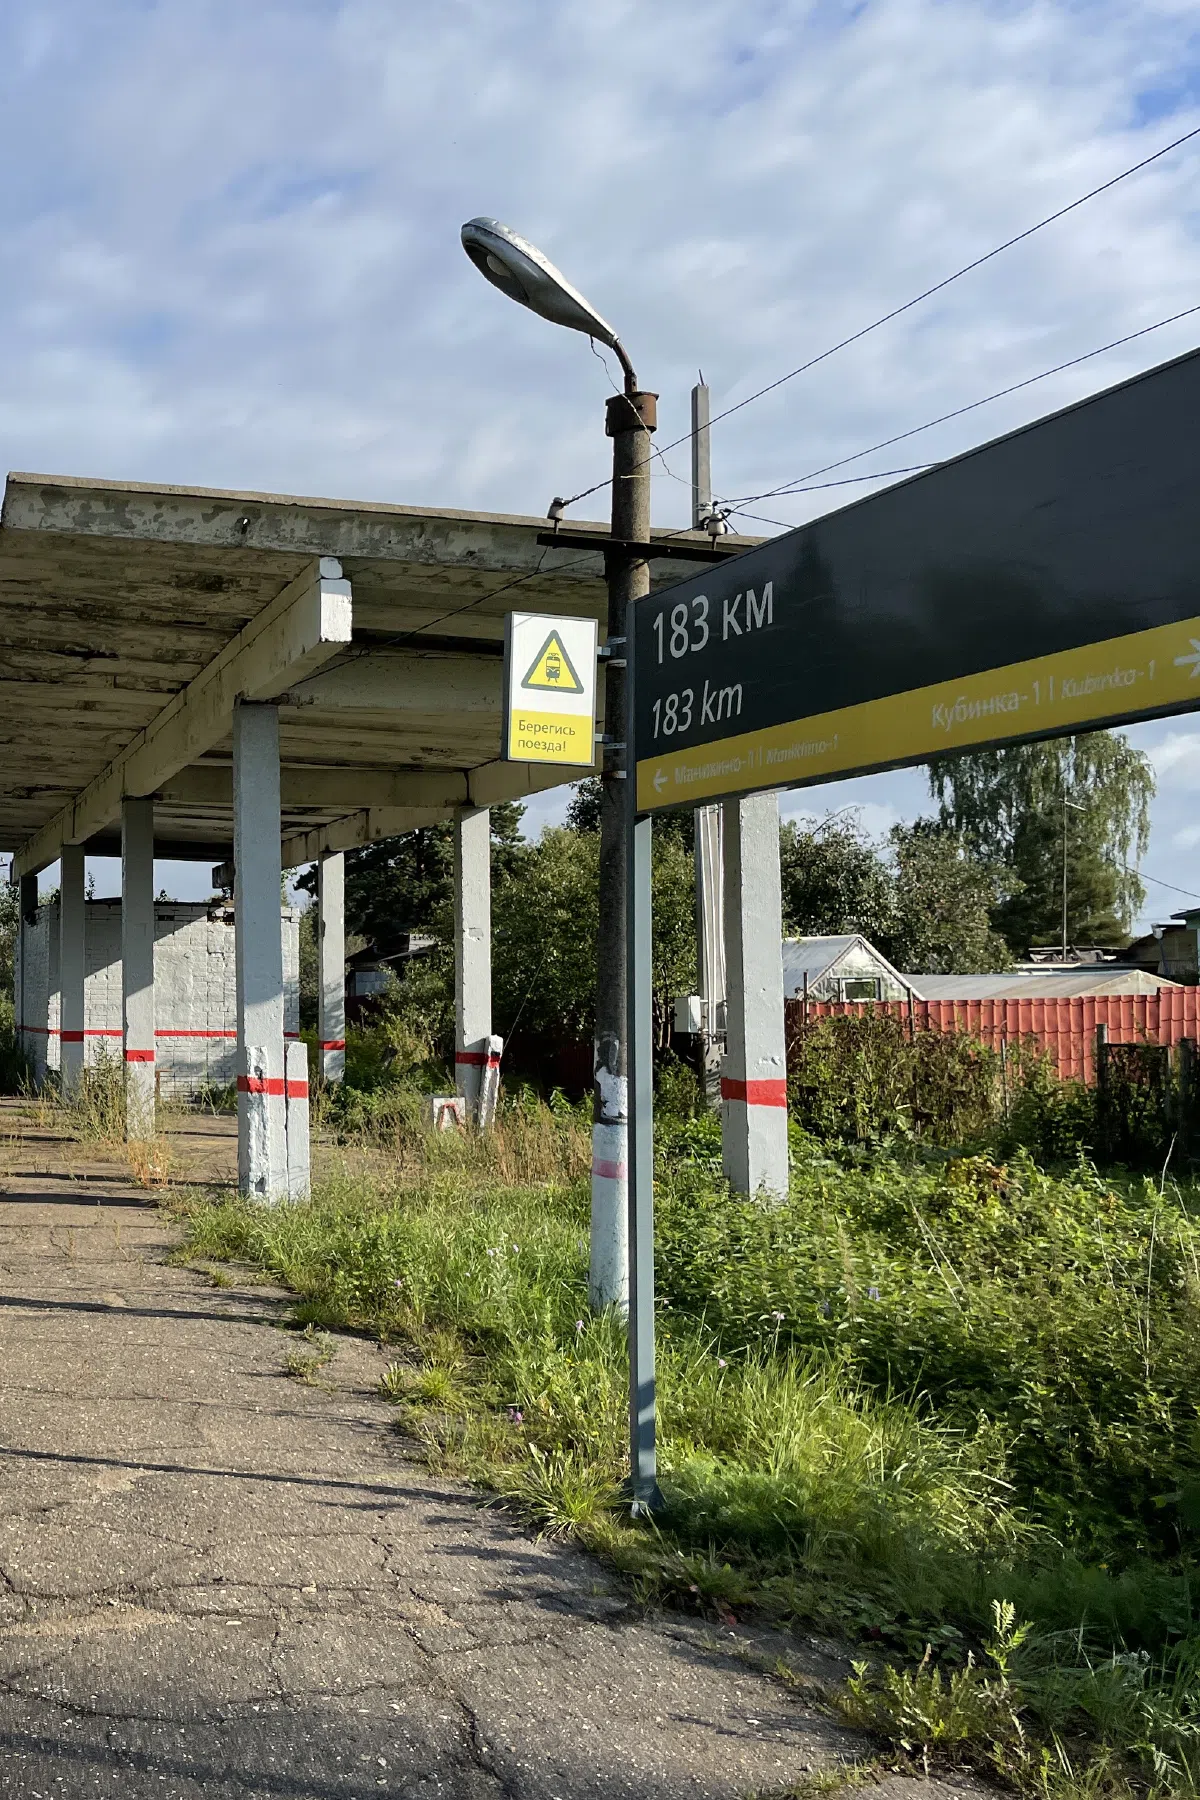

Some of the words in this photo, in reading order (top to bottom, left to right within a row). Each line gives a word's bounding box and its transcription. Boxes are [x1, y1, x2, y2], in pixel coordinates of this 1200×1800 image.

[653, 595, 709, 664] 183
[518, 719, 576, 736] Берегись
[652, 688, 694, 739] 183
[700, 680, 743, 726] km
[931, 680, 1041, 732] Кубинка-1
[518, 738, 567, 753] поезда!
